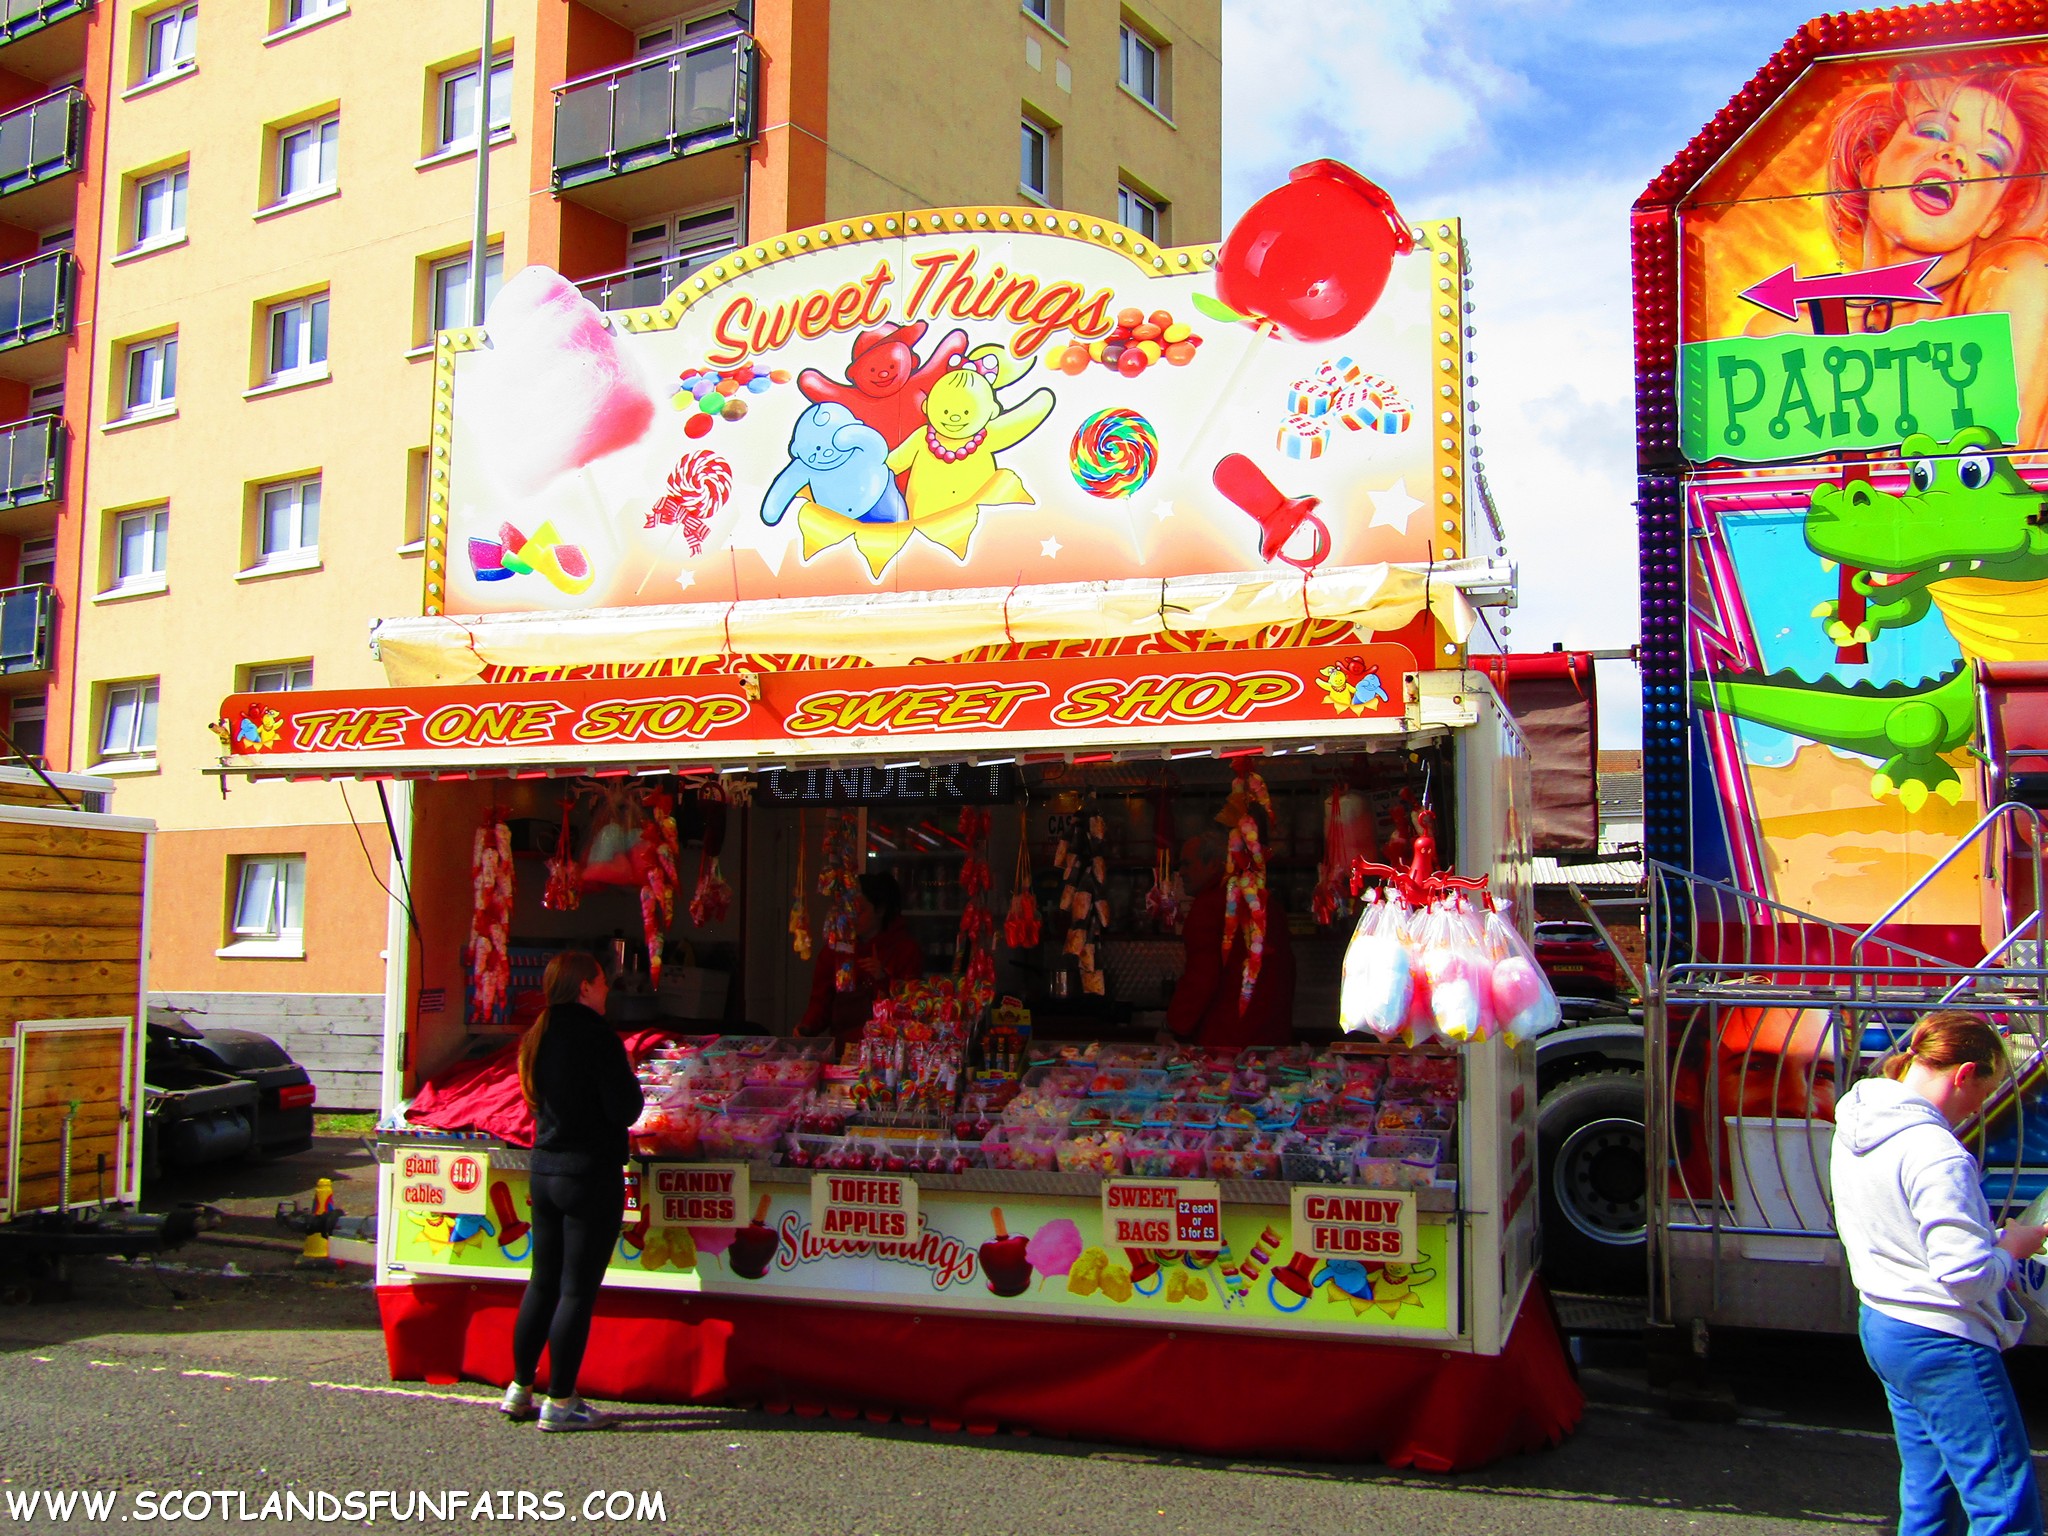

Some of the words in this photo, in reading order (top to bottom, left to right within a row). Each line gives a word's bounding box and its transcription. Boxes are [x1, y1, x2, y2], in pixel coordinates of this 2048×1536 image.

[706, 260, 894, 365] Sweet
[906, 246, 1113, 358] Things
[1717, 340, 1983, 446] PARTY
[294, 707, 420, 751] THE
[425, 702, 570, 746] ONE
[574, 697, 749, 742] STOP
[786, 682, 1046, 734] SWEET
[1051, 673, 1303, 725] SHOP
[771, 763, 963, 799] CINDER
[404, 1154, 439, 1177] giant
[453, 1162, 476, 1184] £1.50
[658, 1171, 734, 1193] CANDY
[404, 1184, 444, 1204] cables
[828, 1178, 901, 1205] TOFFEE
[1108, 1186, 1177, 1208] SWEET
[665, 1198, 734, 1220] FLOSS
[1178, 1202, 1190, 1213] £2
[1192, 1202, 1214, 1214] each
[1192, 1216, 1202, 1226] or
[1307, 1197, 1400, 1223] CANDY
[824, 1209, 906, 1236] APPLES
[1117, 1220, 1170, 1242] BAGS
[1180, 1227, 1187, 1238] 3
[1188, 1227, 1202, 1239] for
[1203, 1227, 1215, 1239] £5
[1315, 1227, 1400, 1253] FLOSS
